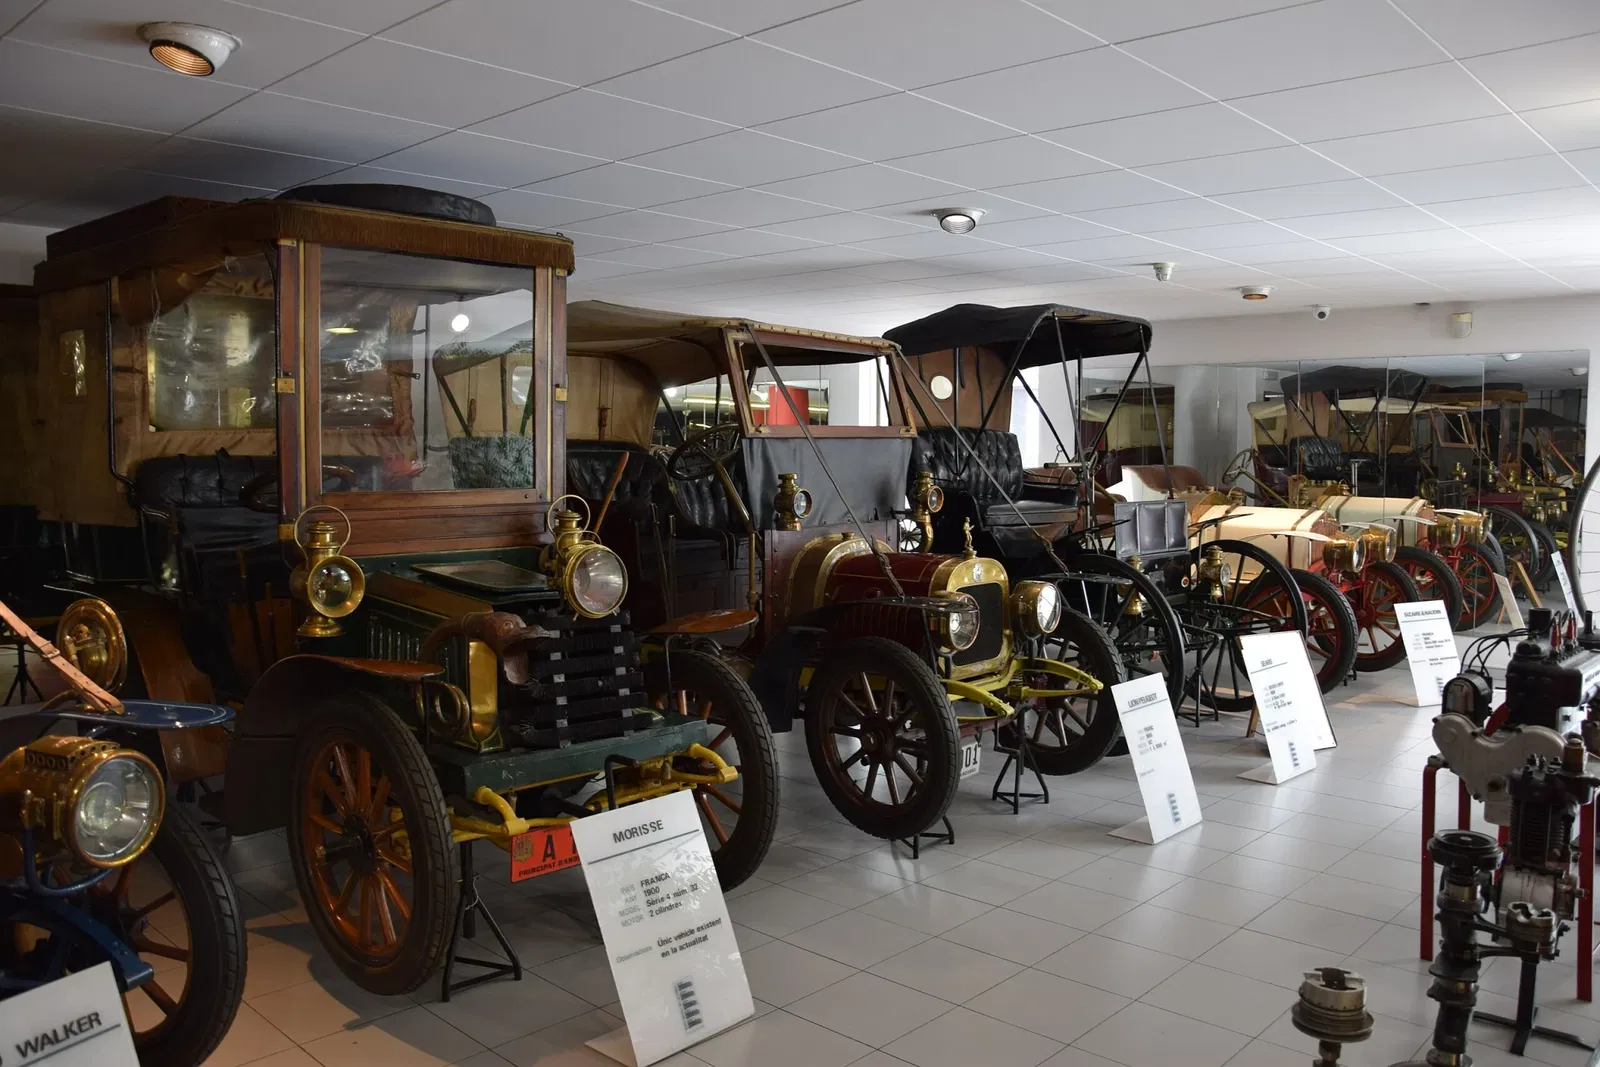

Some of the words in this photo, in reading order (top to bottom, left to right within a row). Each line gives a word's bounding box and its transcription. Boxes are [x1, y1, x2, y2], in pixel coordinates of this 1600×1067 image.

[612, 819, 665, 843] MORISSE
[518, 862, 556, 877] PRINCIPAT
[643, 886, 660, 897] 1900
[621, 914, 644, 927] MOTOR
[648, 909, 654, 917] 2
[655, 901, 683, 916] cilindres
[696, 918, 722, 933] existent
[661, 950, 670, 958] en
[670, 947, 678, 955] la
[679, 934, 709, 951] actualitat
[15, 1011, 103, 1059] WALKER
